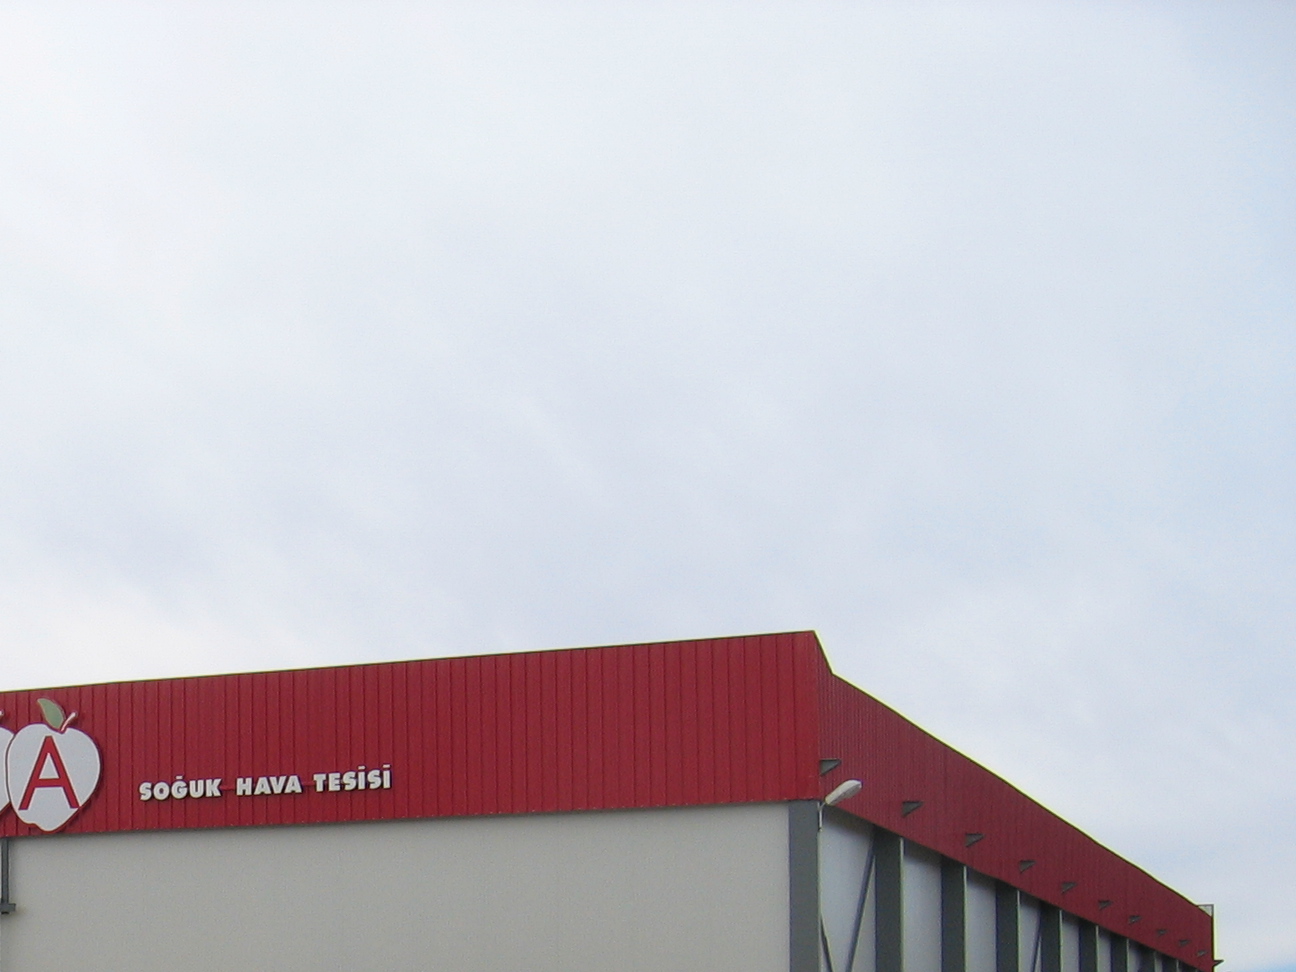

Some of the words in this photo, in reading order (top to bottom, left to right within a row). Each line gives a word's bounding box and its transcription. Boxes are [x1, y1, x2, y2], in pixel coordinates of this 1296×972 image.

[139, 775, 222, 802] SOĞUK
[235, 774, 303, 797] HAVA
[312, 764, 392, 793] TESİSİ
